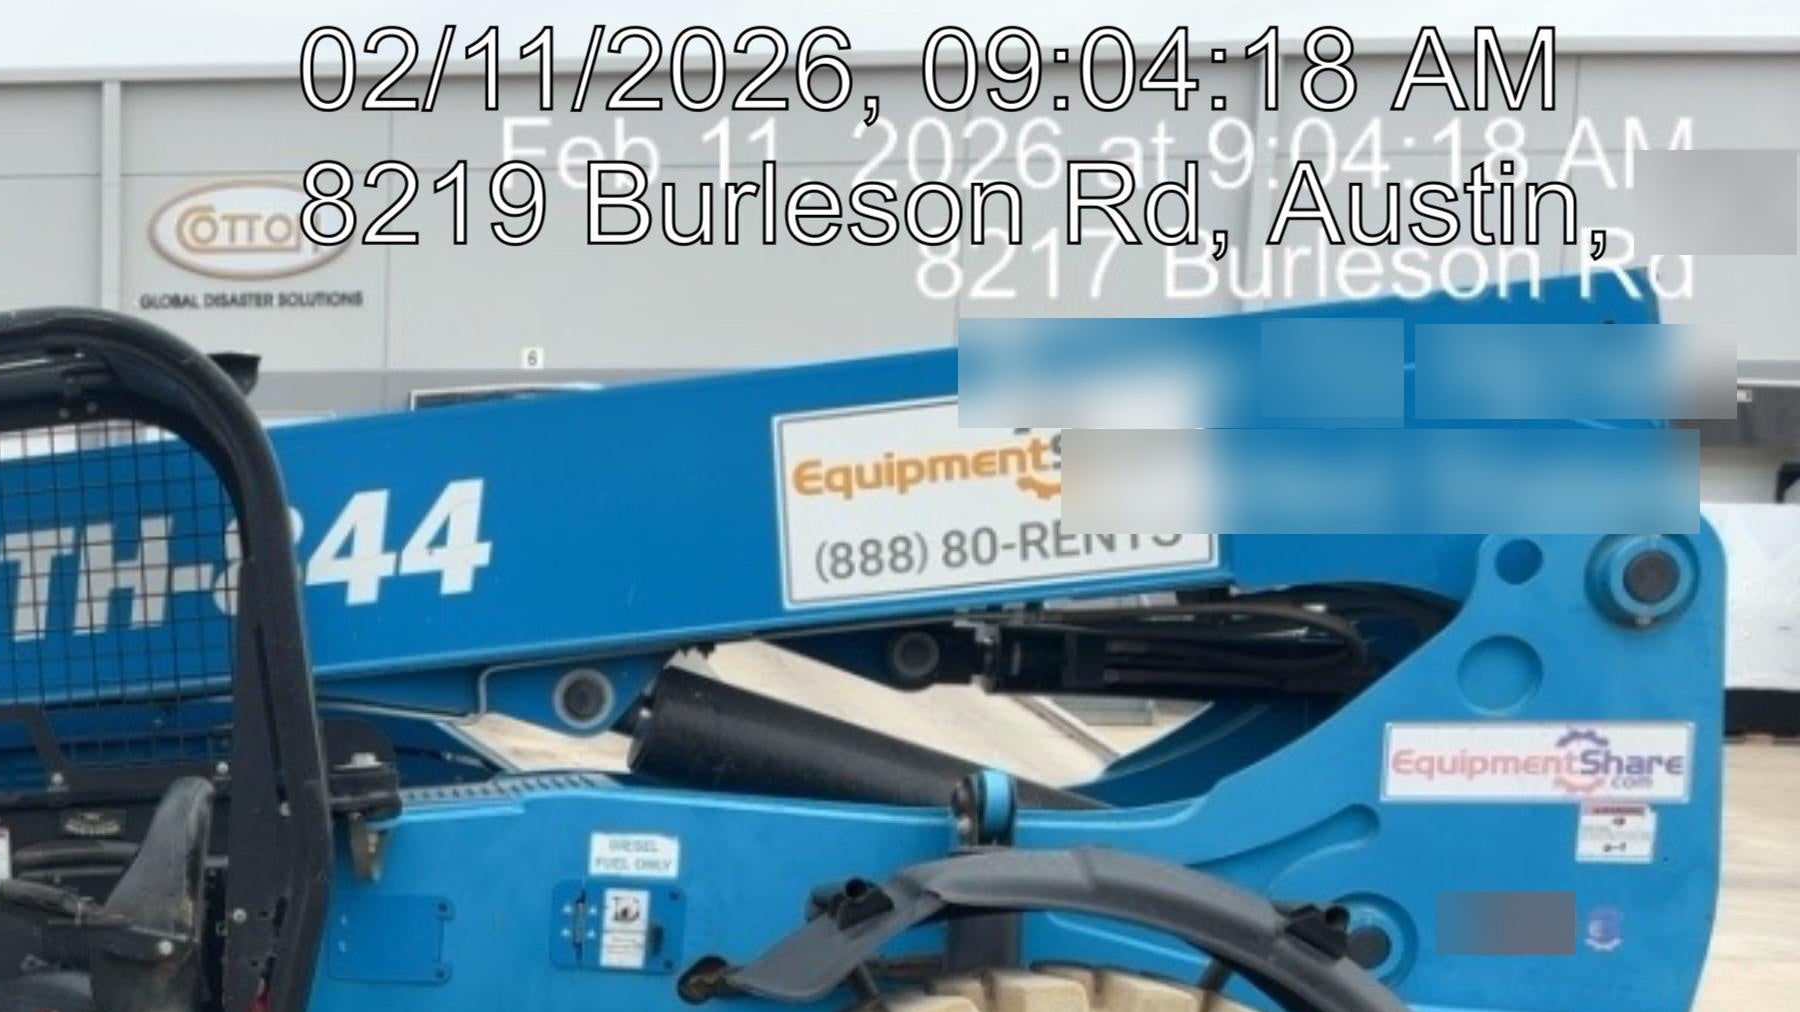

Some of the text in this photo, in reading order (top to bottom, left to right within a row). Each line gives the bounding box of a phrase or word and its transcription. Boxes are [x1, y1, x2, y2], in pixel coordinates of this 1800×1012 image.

[140, 290, 363, 310] GLOBAL DISASTER SOLUTIONS
[527, 349, 538, 367] 6
[816, 532, 929, 584] (888)
[1391, 748, 1686, 781] EquipmentShare
